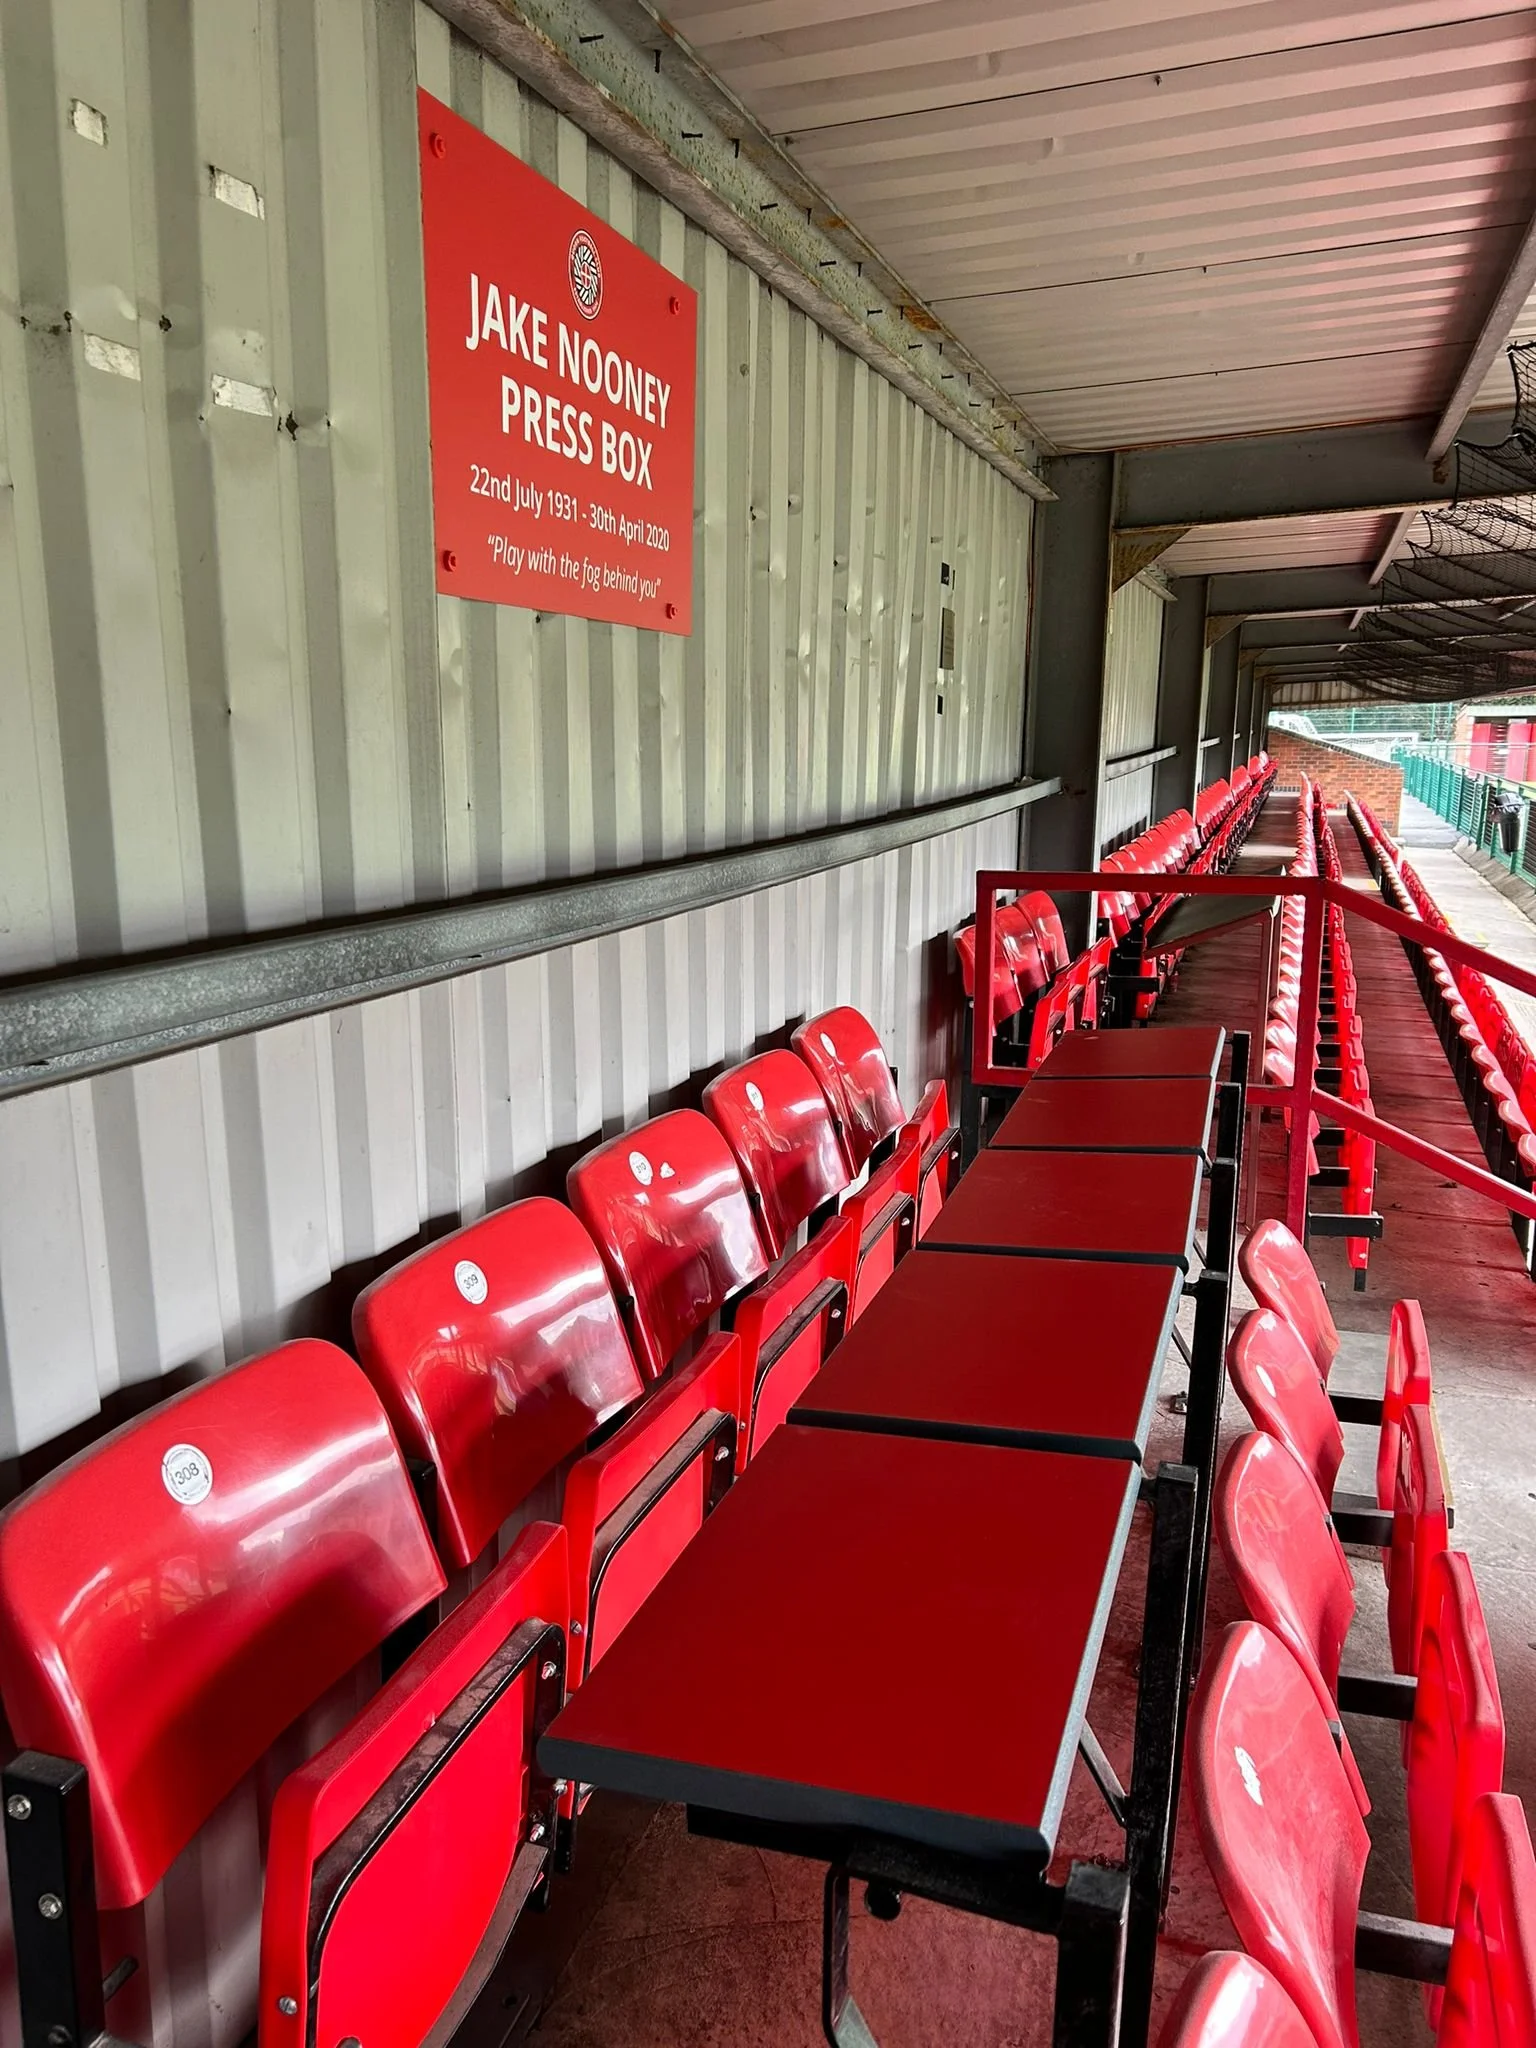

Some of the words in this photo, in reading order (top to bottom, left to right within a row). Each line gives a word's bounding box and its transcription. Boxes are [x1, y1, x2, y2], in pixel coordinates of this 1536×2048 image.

[466, 273, 548, 369] JAKE
[559, 322, 671, 429] NOONEY
[502, 375, 593, 465] PRESS
[602, 421, 653, 491] BOX
[470, 464, 511, 503] 22nd
[513, 479, 543, 519] July
[548, 489, 578, 523] 1931
[589, 504, 617, 535] 30th
[619, 513, 644, 546] April
[647, 523, 670, 552] 2020
[528, 546, 556, 576] with
[560, 554, 580, 580] the
[581, 556, 600, 593] fog
[602, 562, 638, 595] behind
[464, 1273, 479, 1290] 309
[175, 1462, 200, 1485] 308
